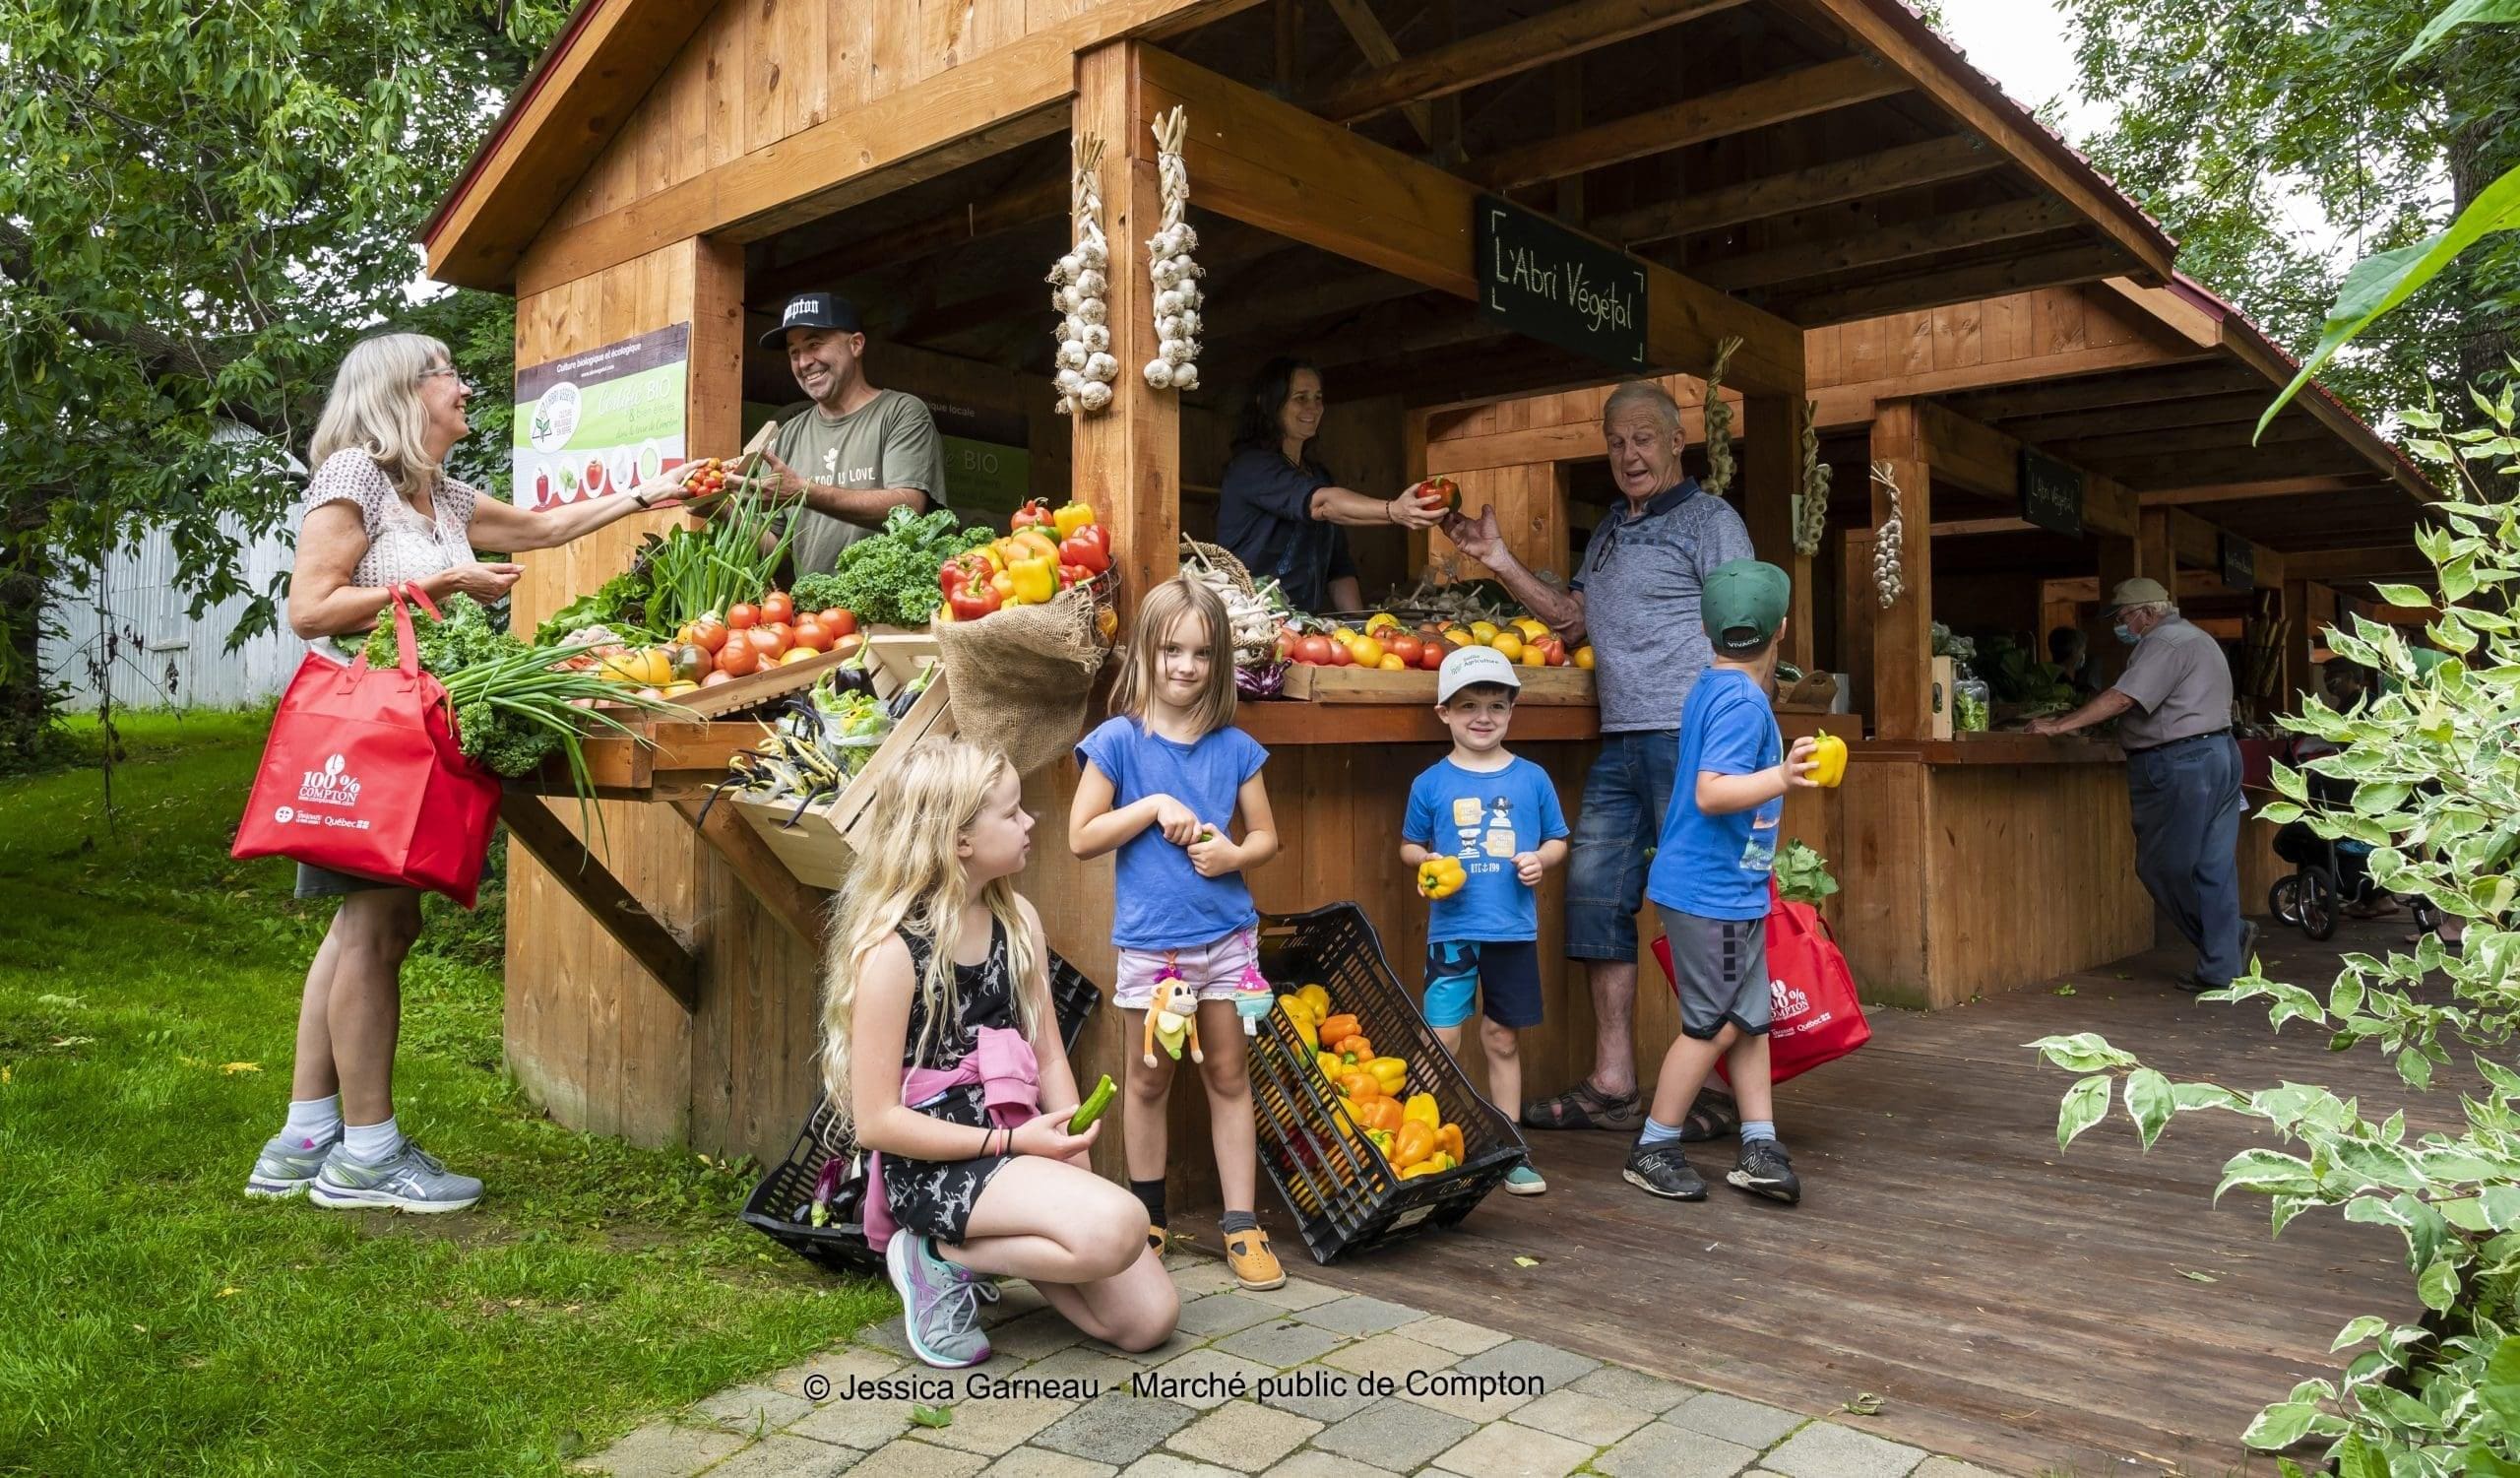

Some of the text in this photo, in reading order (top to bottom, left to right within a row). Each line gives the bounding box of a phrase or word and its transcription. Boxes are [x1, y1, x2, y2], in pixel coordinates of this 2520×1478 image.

[1494, 235, 1632, 333] L'Abri Végétal
[647, 376, 671, 402] BIO
[949, 401, 976, 418] locale
[964, 449, 999, 475] BIO
[838, 472, 846, 485] IS
[849, 467, 876, 482] LOVE
[300, 771, 337, 789] 100
[299, 787, 359, 802] COMPTON
[324, 816, 356, 828] Québec
[1771, 996, 1789, 1010] 00
[1771, 1000, 1808, 1018] OMPTON
